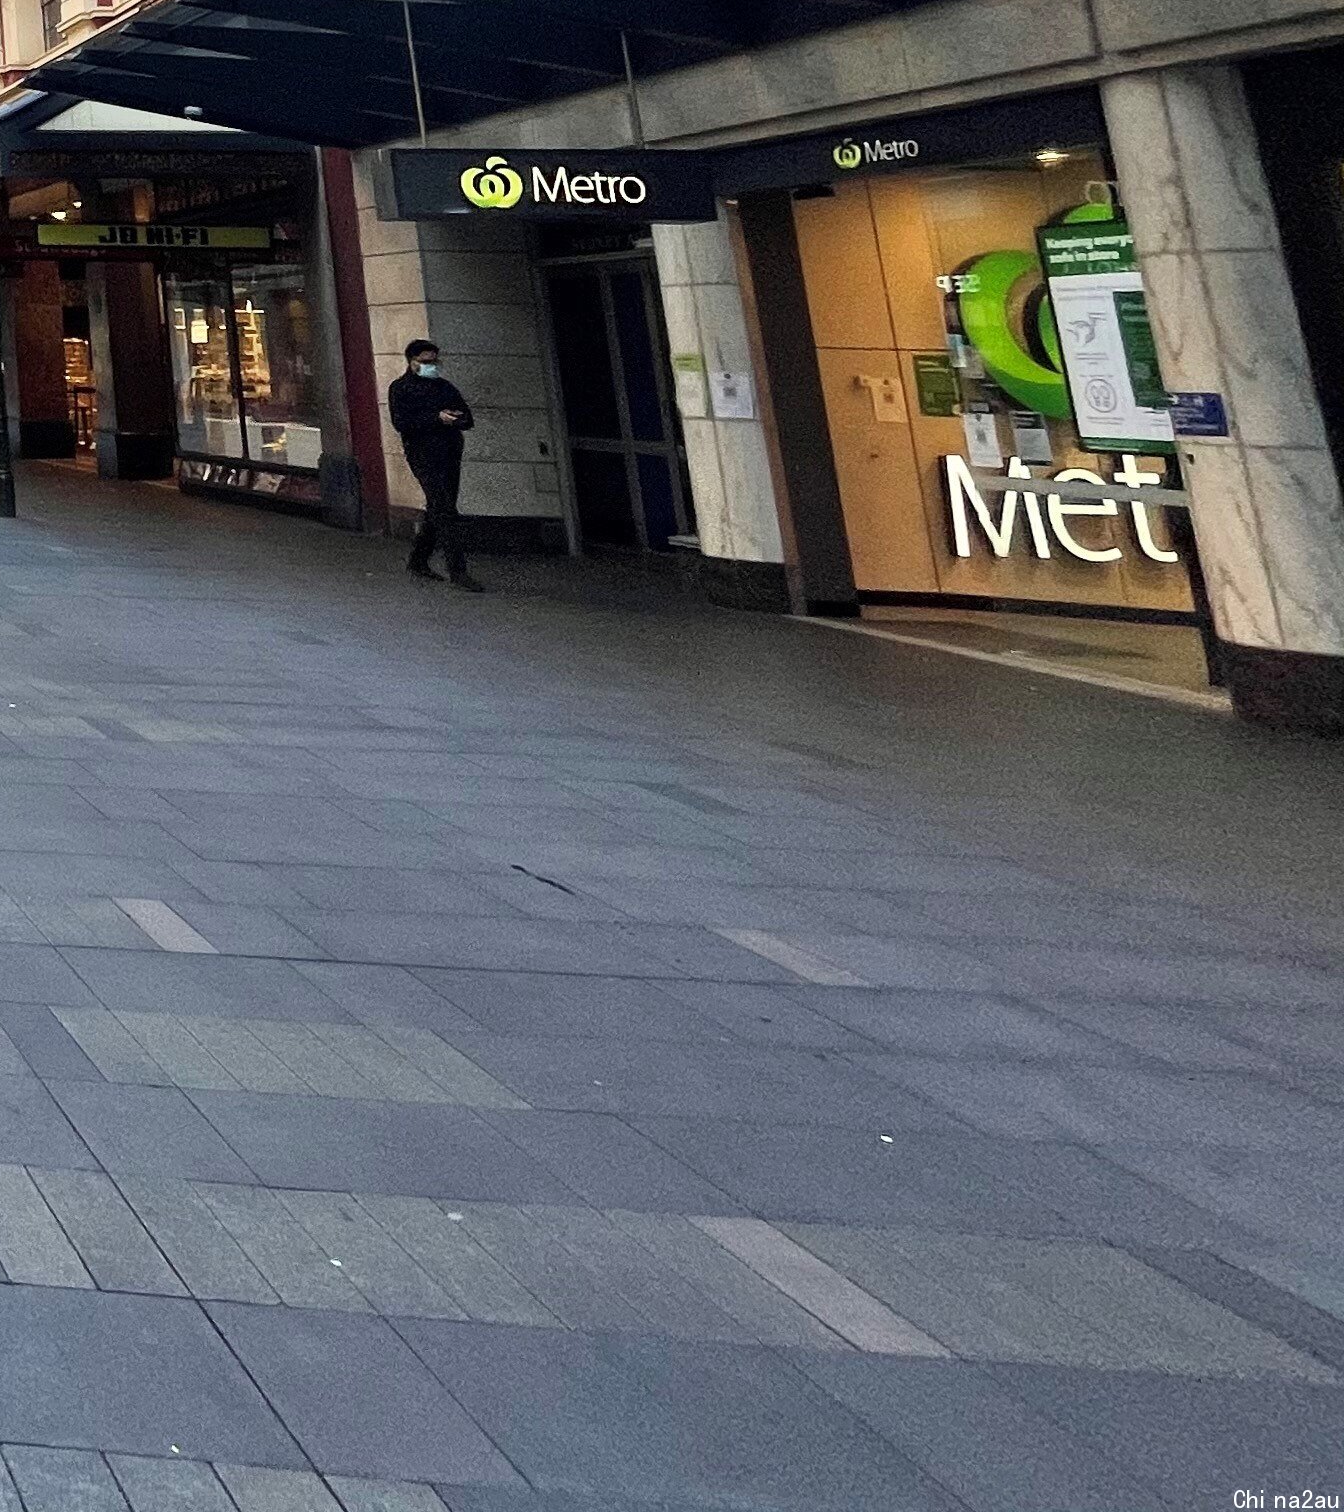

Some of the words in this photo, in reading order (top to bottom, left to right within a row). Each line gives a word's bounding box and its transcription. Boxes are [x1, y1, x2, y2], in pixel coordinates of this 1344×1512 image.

[864, 139, 919, 164] Metro
[532, 166, 646, 204] Metro
[98, 227, 137, 244] JB
